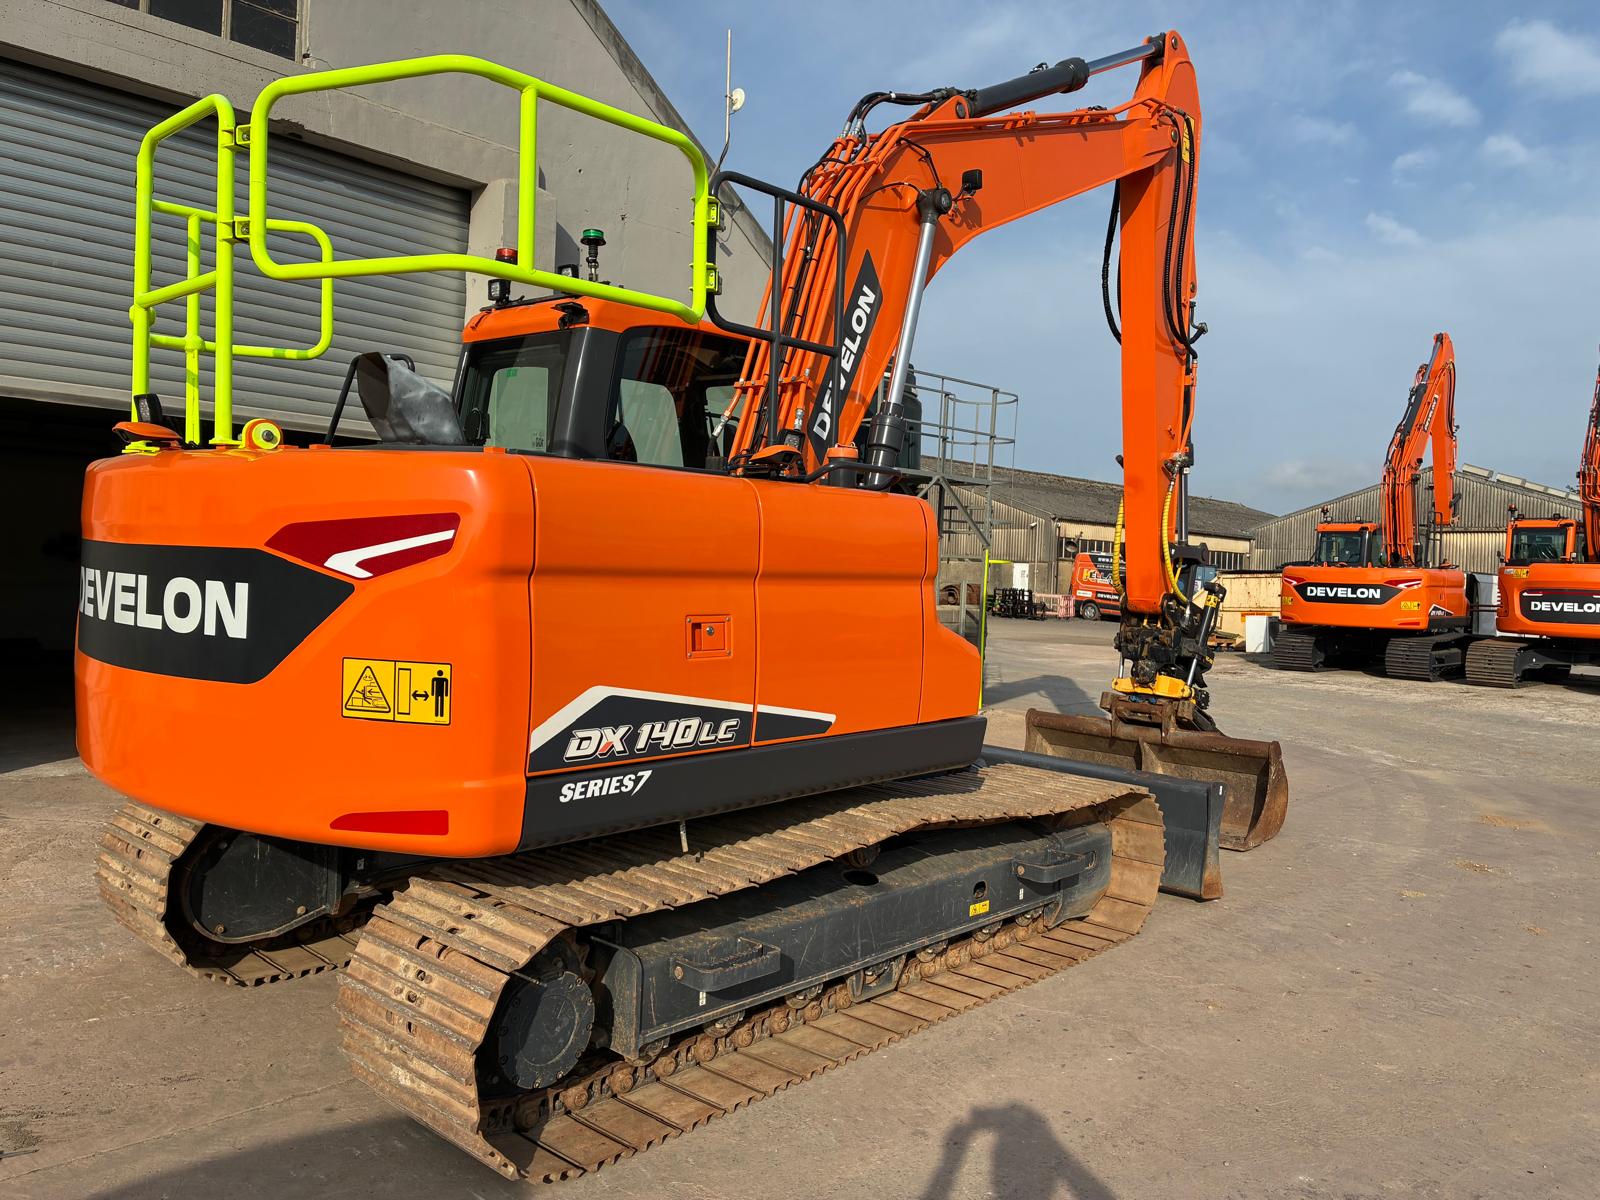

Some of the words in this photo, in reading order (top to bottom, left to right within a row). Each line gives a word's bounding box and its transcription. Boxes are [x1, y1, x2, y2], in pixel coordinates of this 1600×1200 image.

[79, 566, 249, 639] DEVELON
[1307, 586, 1381, 599] DEVELON
[564, 724, 633, 762] DX
